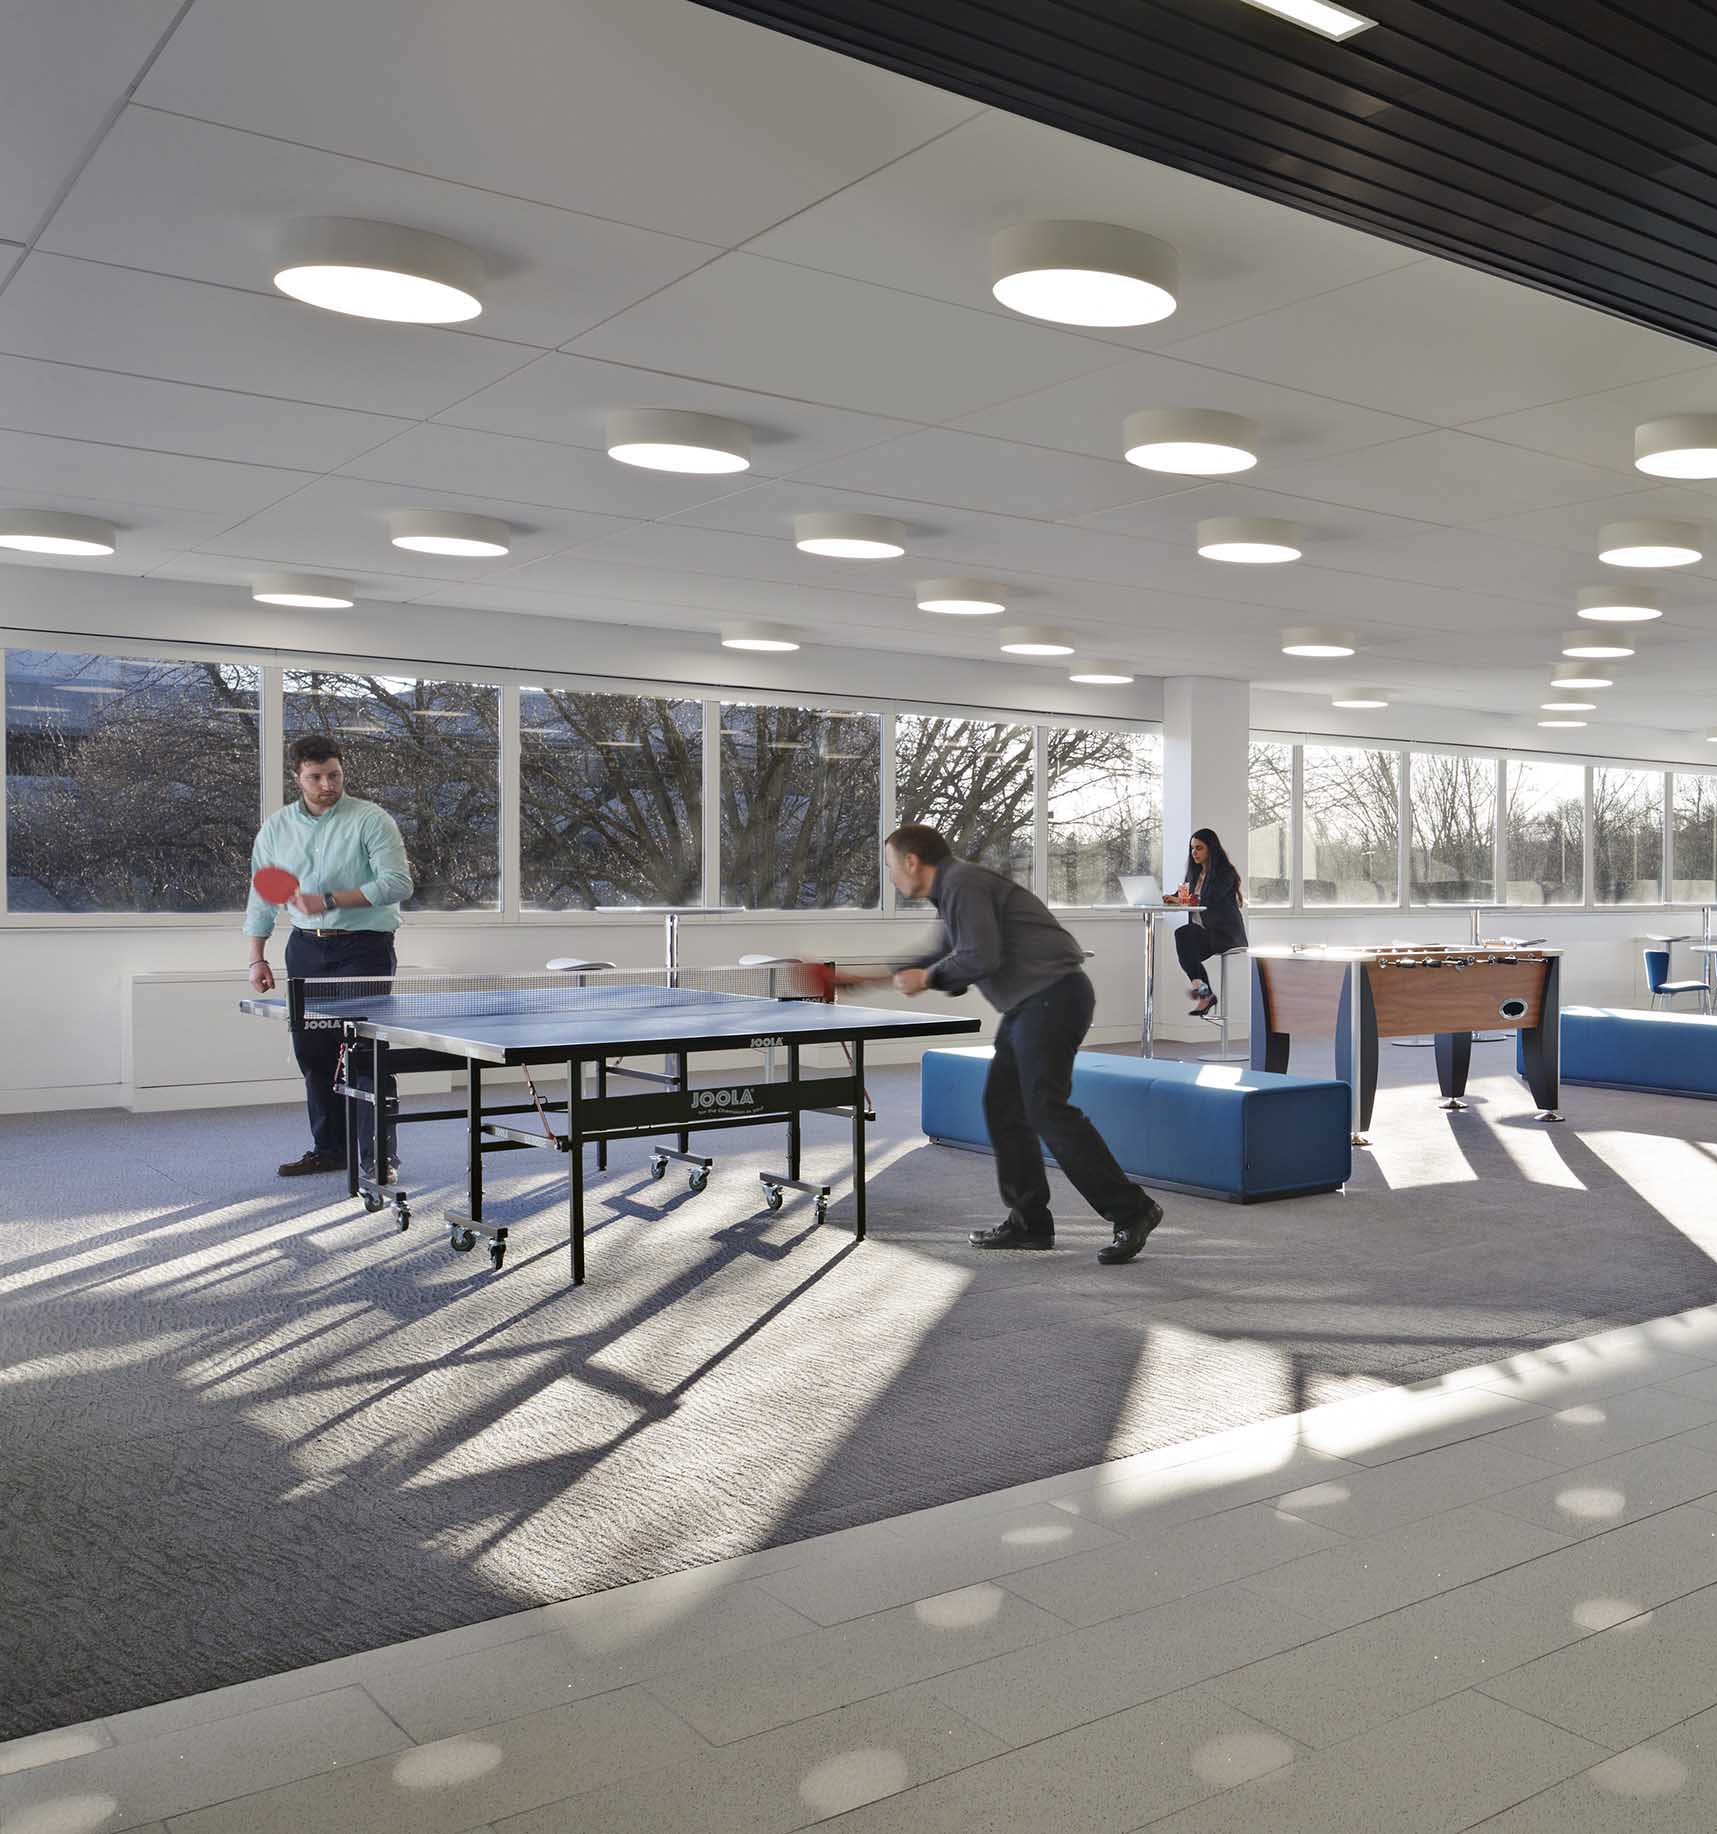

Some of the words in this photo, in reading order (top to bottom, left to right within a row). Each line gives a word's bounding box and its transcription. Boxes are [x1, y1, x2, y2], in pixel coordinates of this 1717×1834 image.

[304, 1019, 341, 1030] JOOLA
[750, 1036, 784, 1048] JOOLA
[691, 1088, 754, 1109] JOOLA
